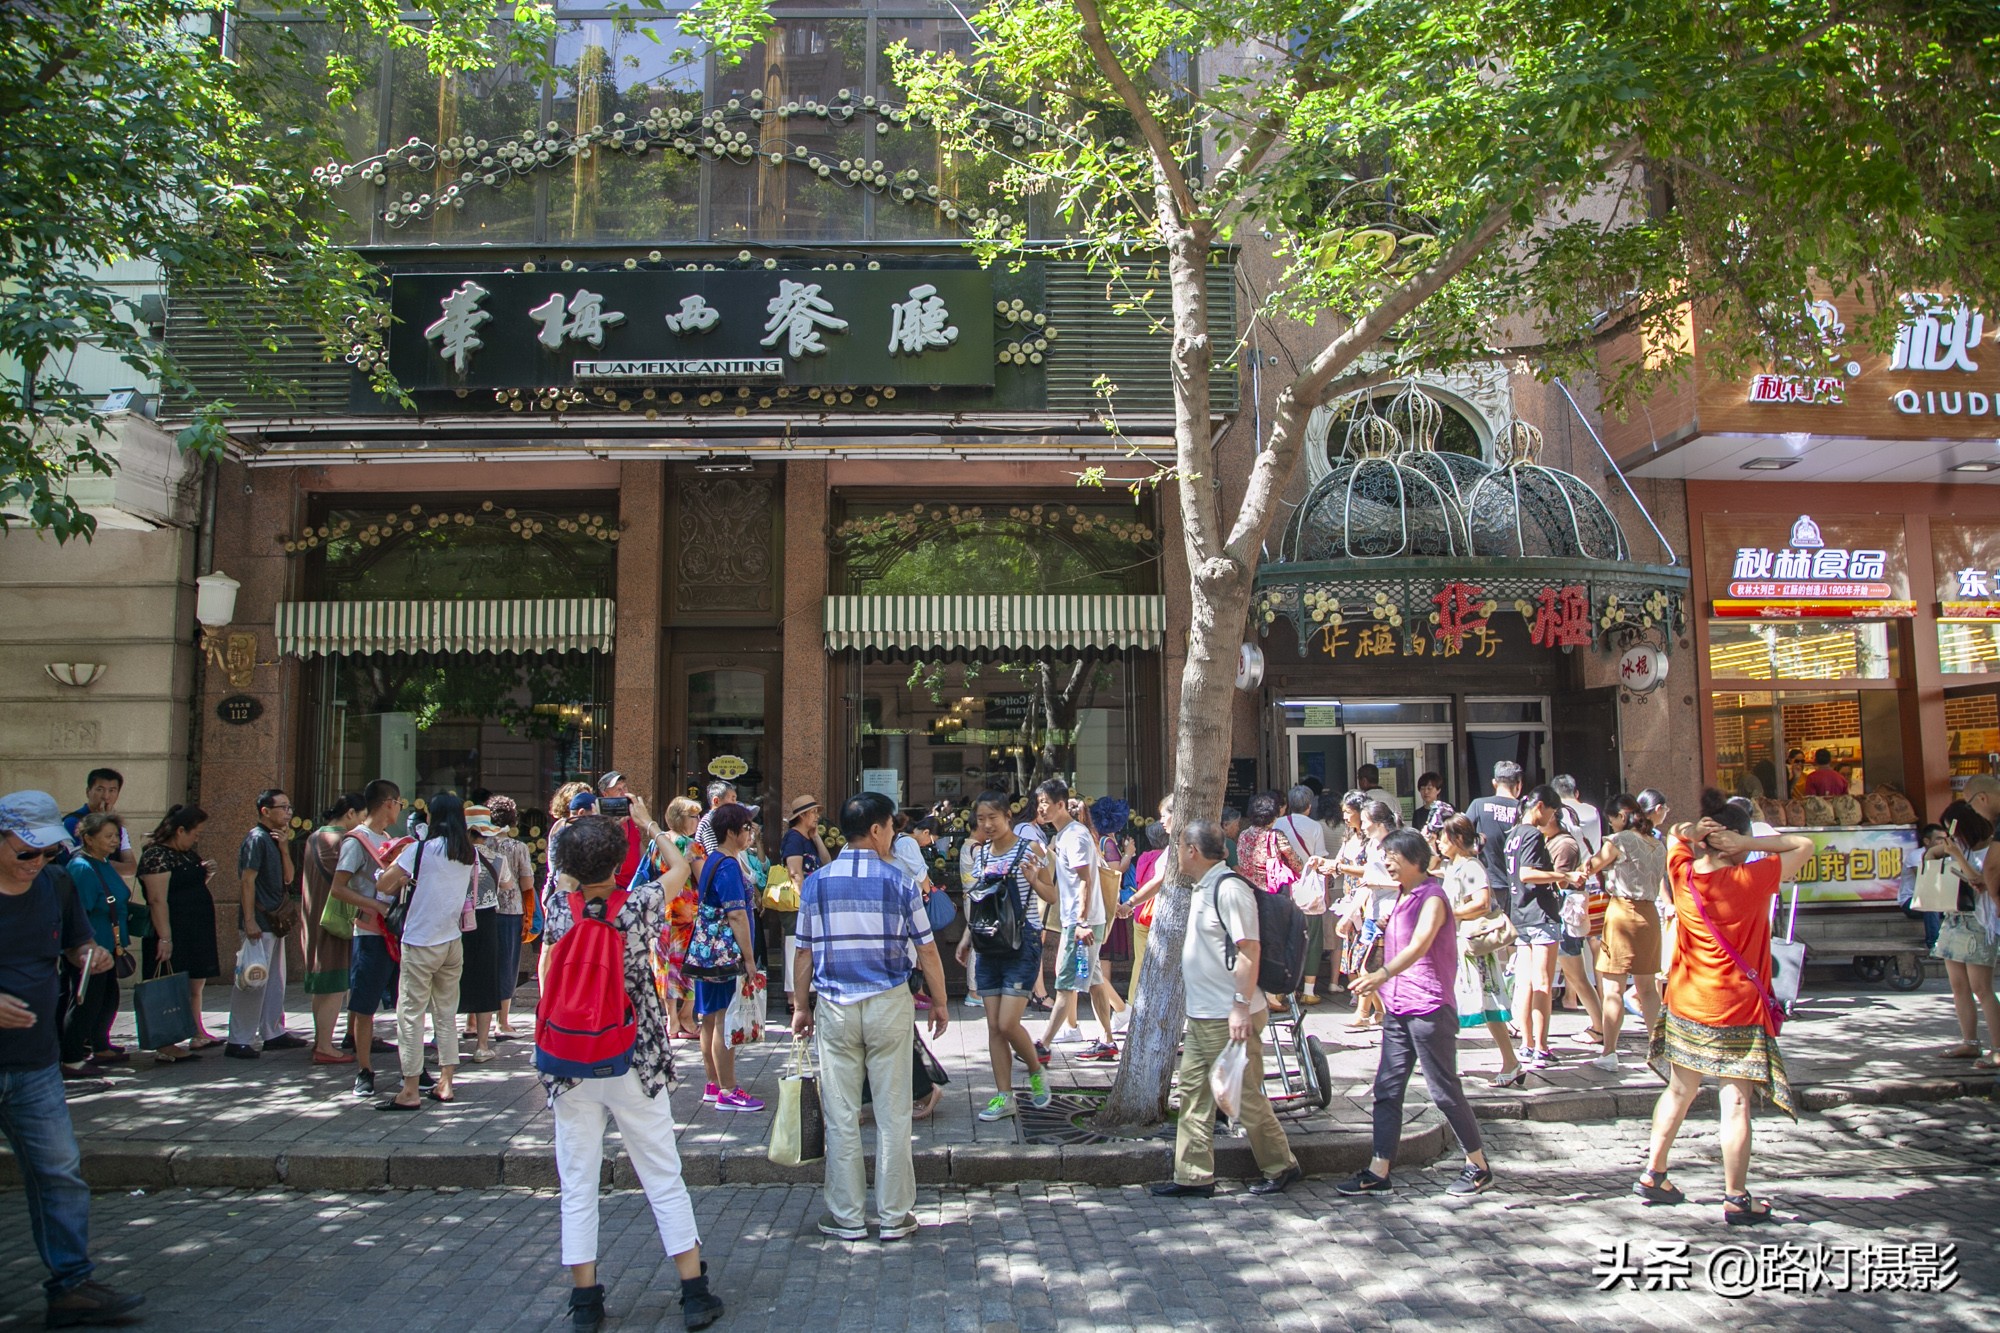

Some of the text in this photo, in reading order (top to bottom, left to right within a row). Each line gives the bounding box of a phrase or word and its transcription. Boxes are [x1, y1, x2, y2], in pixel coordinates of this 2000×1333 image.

[424, 280, 959, 376] 華梅西餐廳
[575, 361, 780, 374] HUAMEIXICANTING
[1733, 548, 1886, 580] 秋林食品
[1431, 582, 1592, 648] 华梅
[1622, 654, 1649, 680] 冰棍
[231, 709, 248, 719] 112
